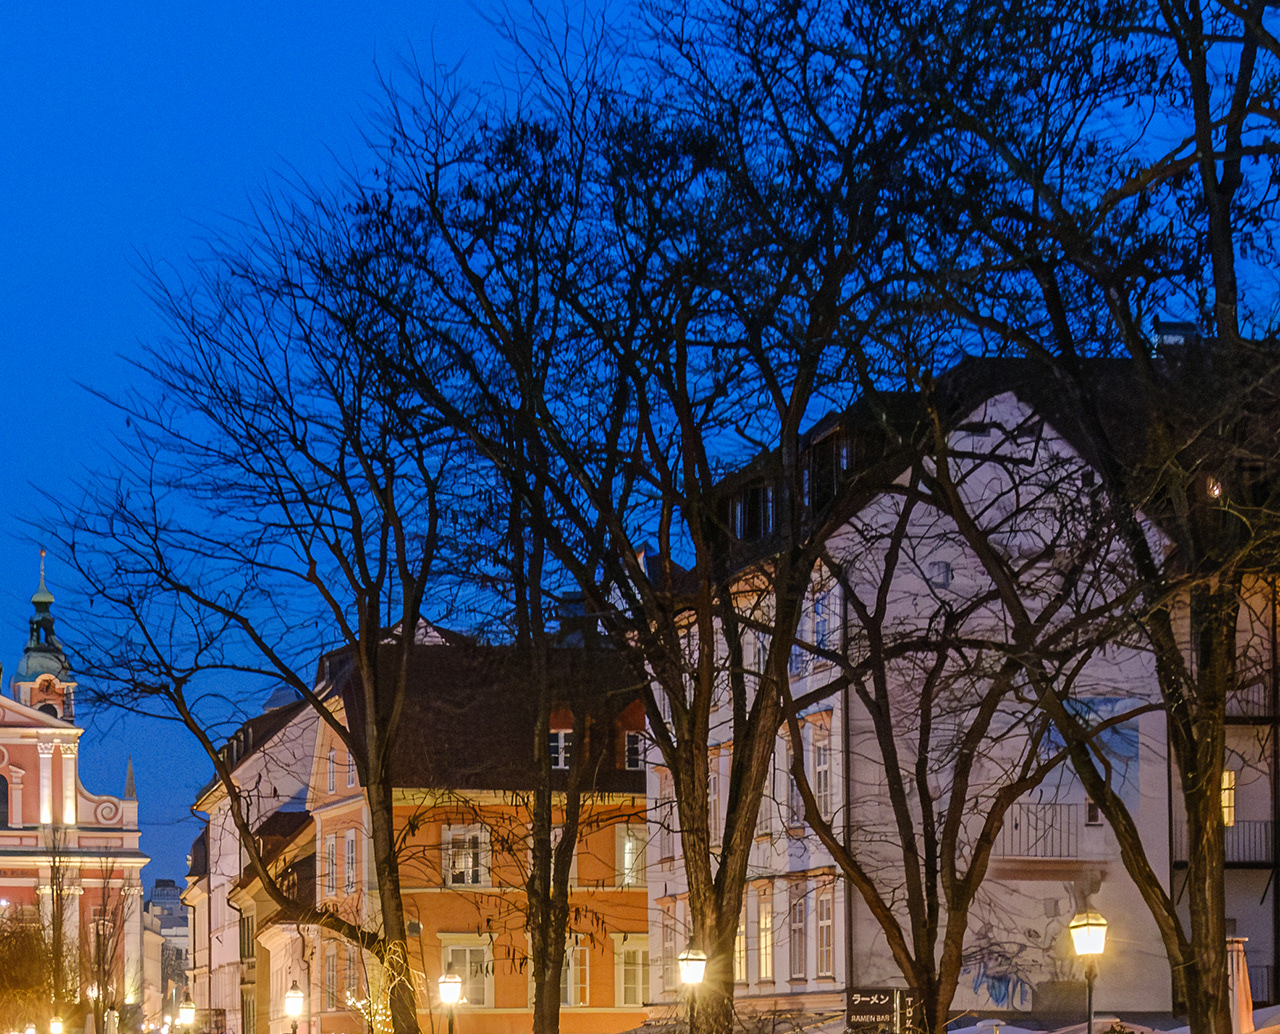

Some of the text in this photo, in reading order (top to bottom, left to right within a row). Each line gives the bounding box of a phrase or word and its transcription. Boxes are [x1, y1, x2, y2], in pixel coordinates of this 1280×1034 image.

[852, 993, 890, 1005] ラーメン
[851, 1014, 890, 1023] RAMEN BAR
